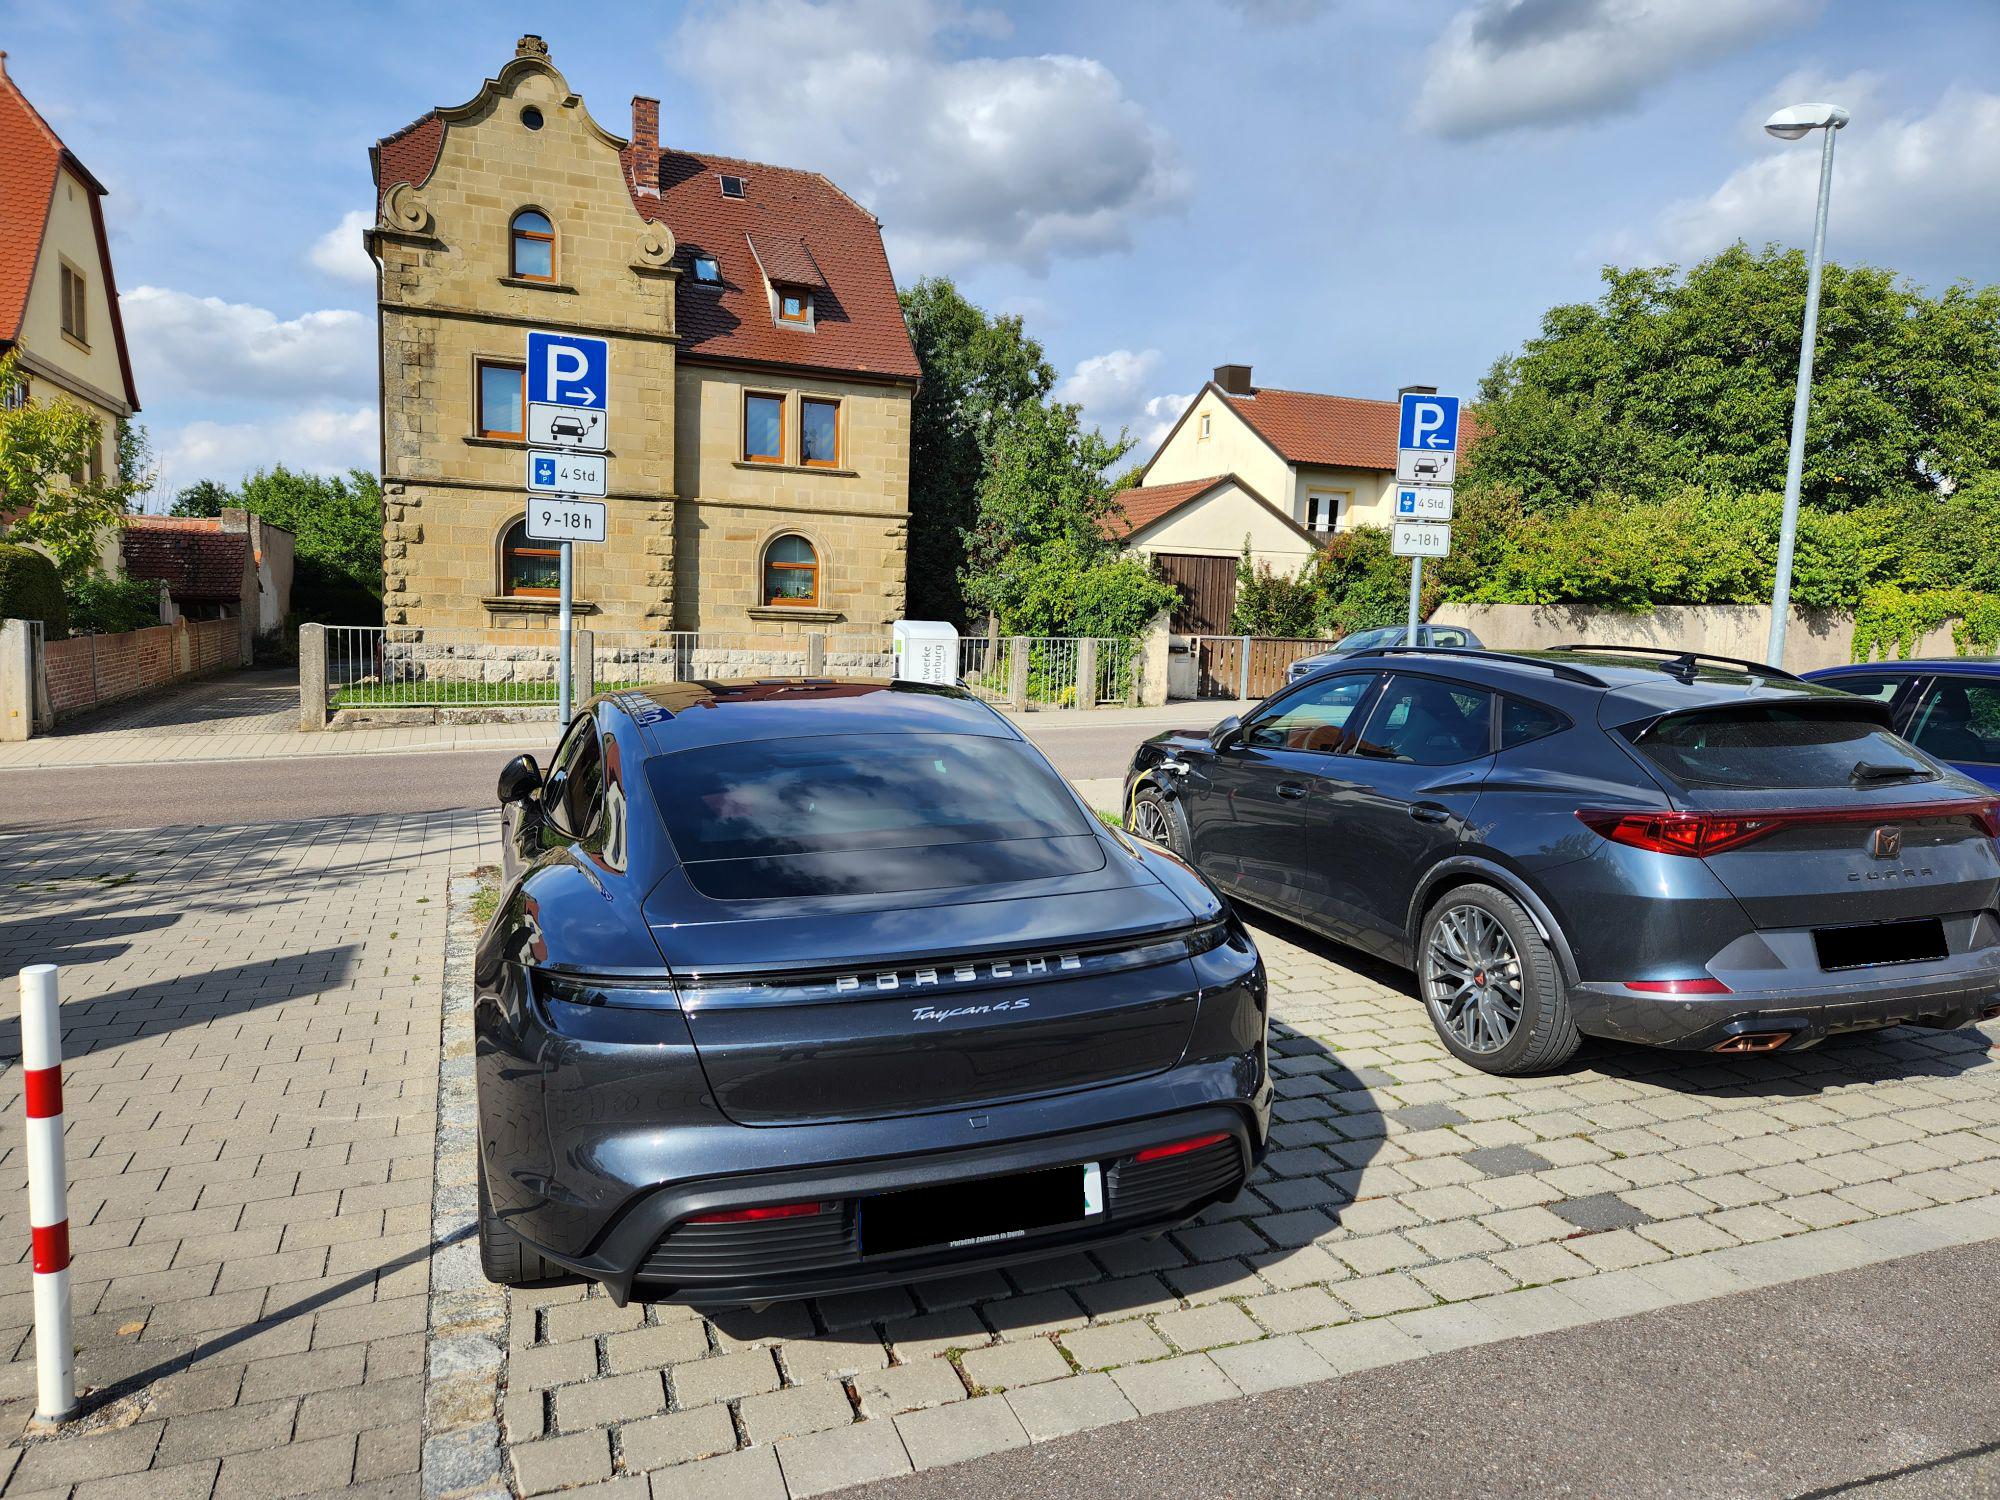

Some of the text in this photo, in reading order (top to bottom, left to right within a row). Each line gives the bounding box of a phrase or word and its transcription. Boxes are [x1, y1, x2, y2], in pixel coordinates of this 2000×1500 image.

[547, 344, 589, 402] P
[1412, 402, 1445, 447] P
[560, 467, 599, 483] 4 Std.
[1418, 498, 1446, 509] 4 Std.
[835, 954, 1082, 993] PORSCHE
[912, 1006, 991, 1023] Taycan
